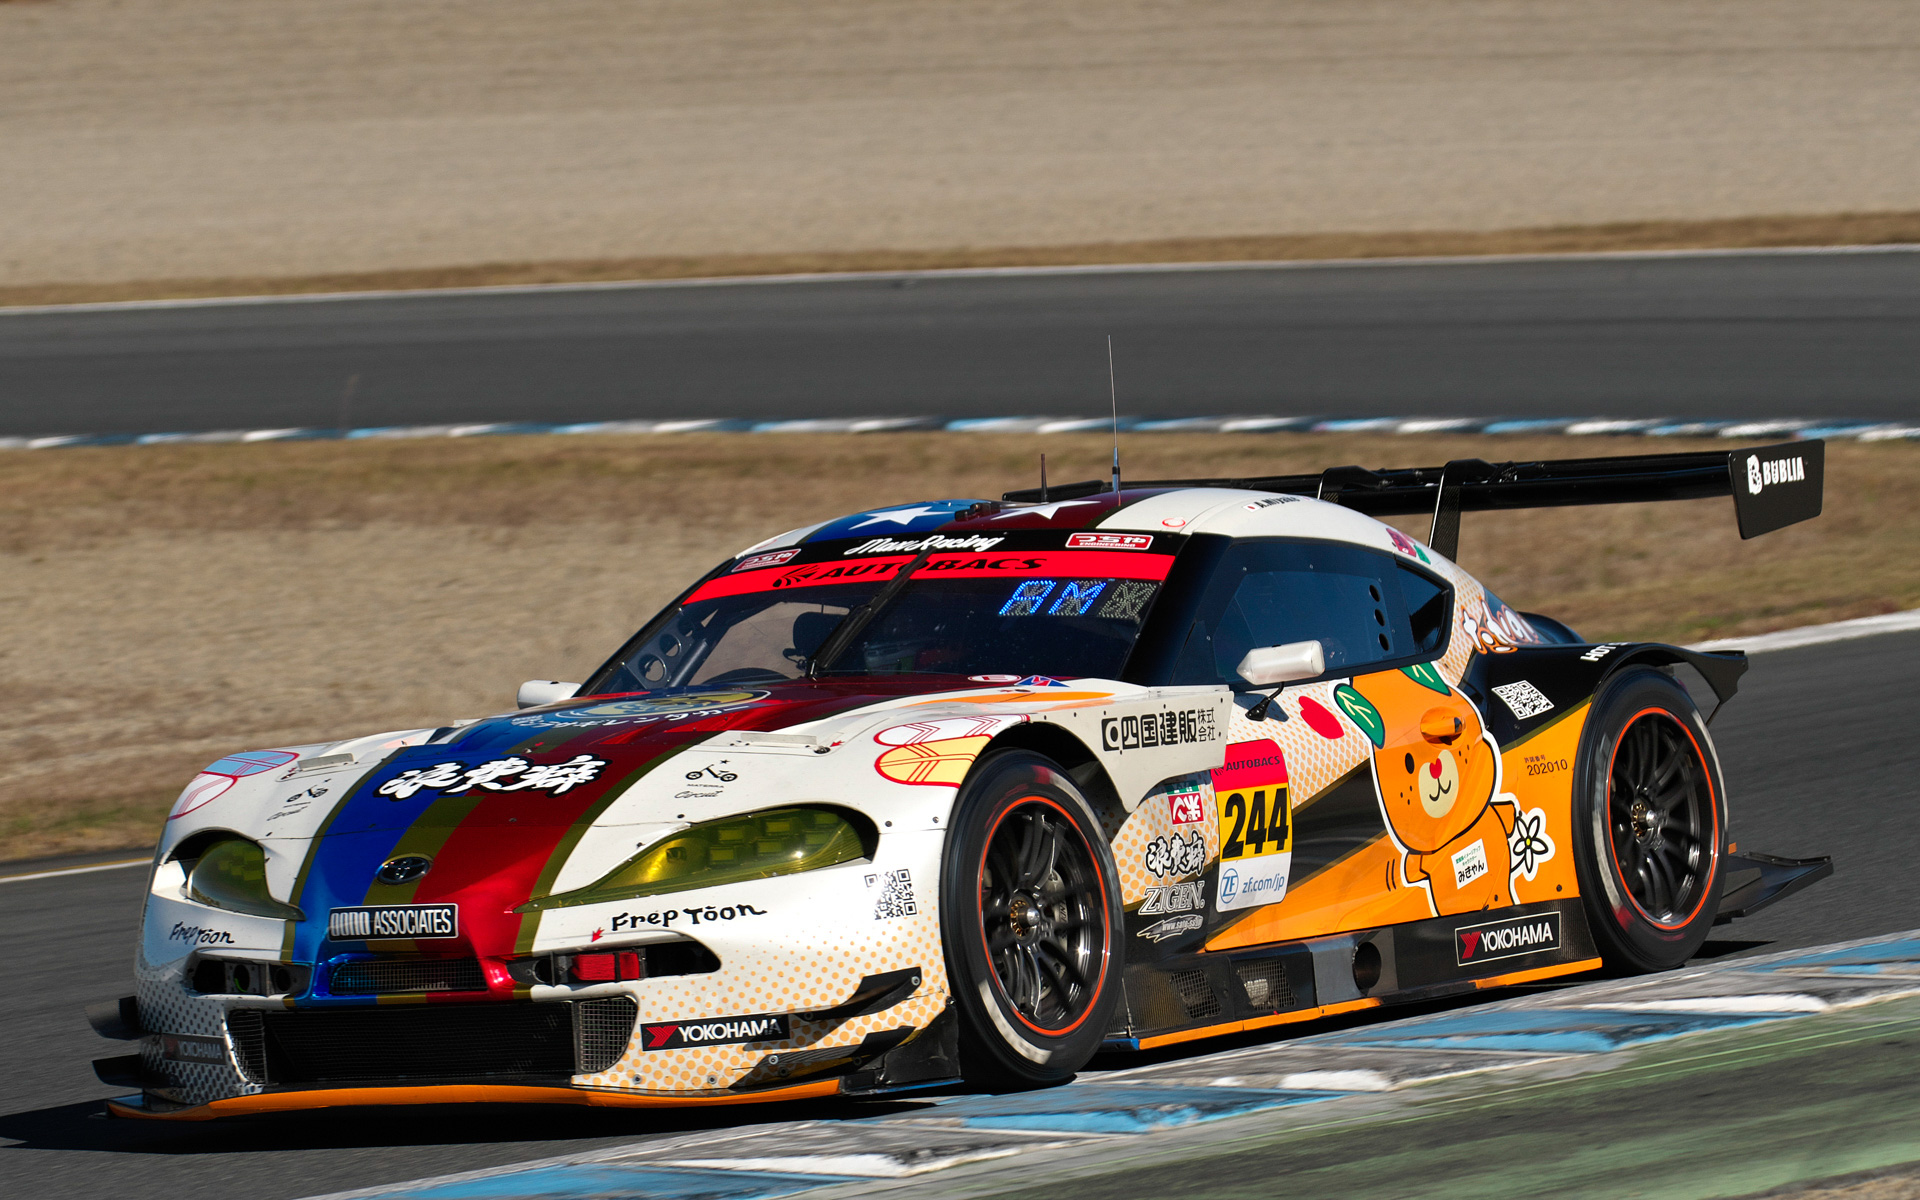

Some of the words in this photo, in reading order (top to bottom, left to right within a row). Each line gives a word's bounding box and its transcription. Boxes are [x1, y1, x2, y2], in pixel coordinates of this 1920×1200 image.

[916, 534, 1005, 552] Racing
[1121, 710, 1198, 750] 四国建販
[1226, 755, 1281, 771] AUTOBACS
[1527, 758, 1568, 776] 202010
[1222, 787, 1289, 859] 244
[1242, 873, 1285, 894] zf.com/jp
[374, 908, 452, 935] ASSOCIATES
[1480, 921, 1554, 953] YOKOHAMA
[677, 1018, 783, 1043] YOKOHAMA
